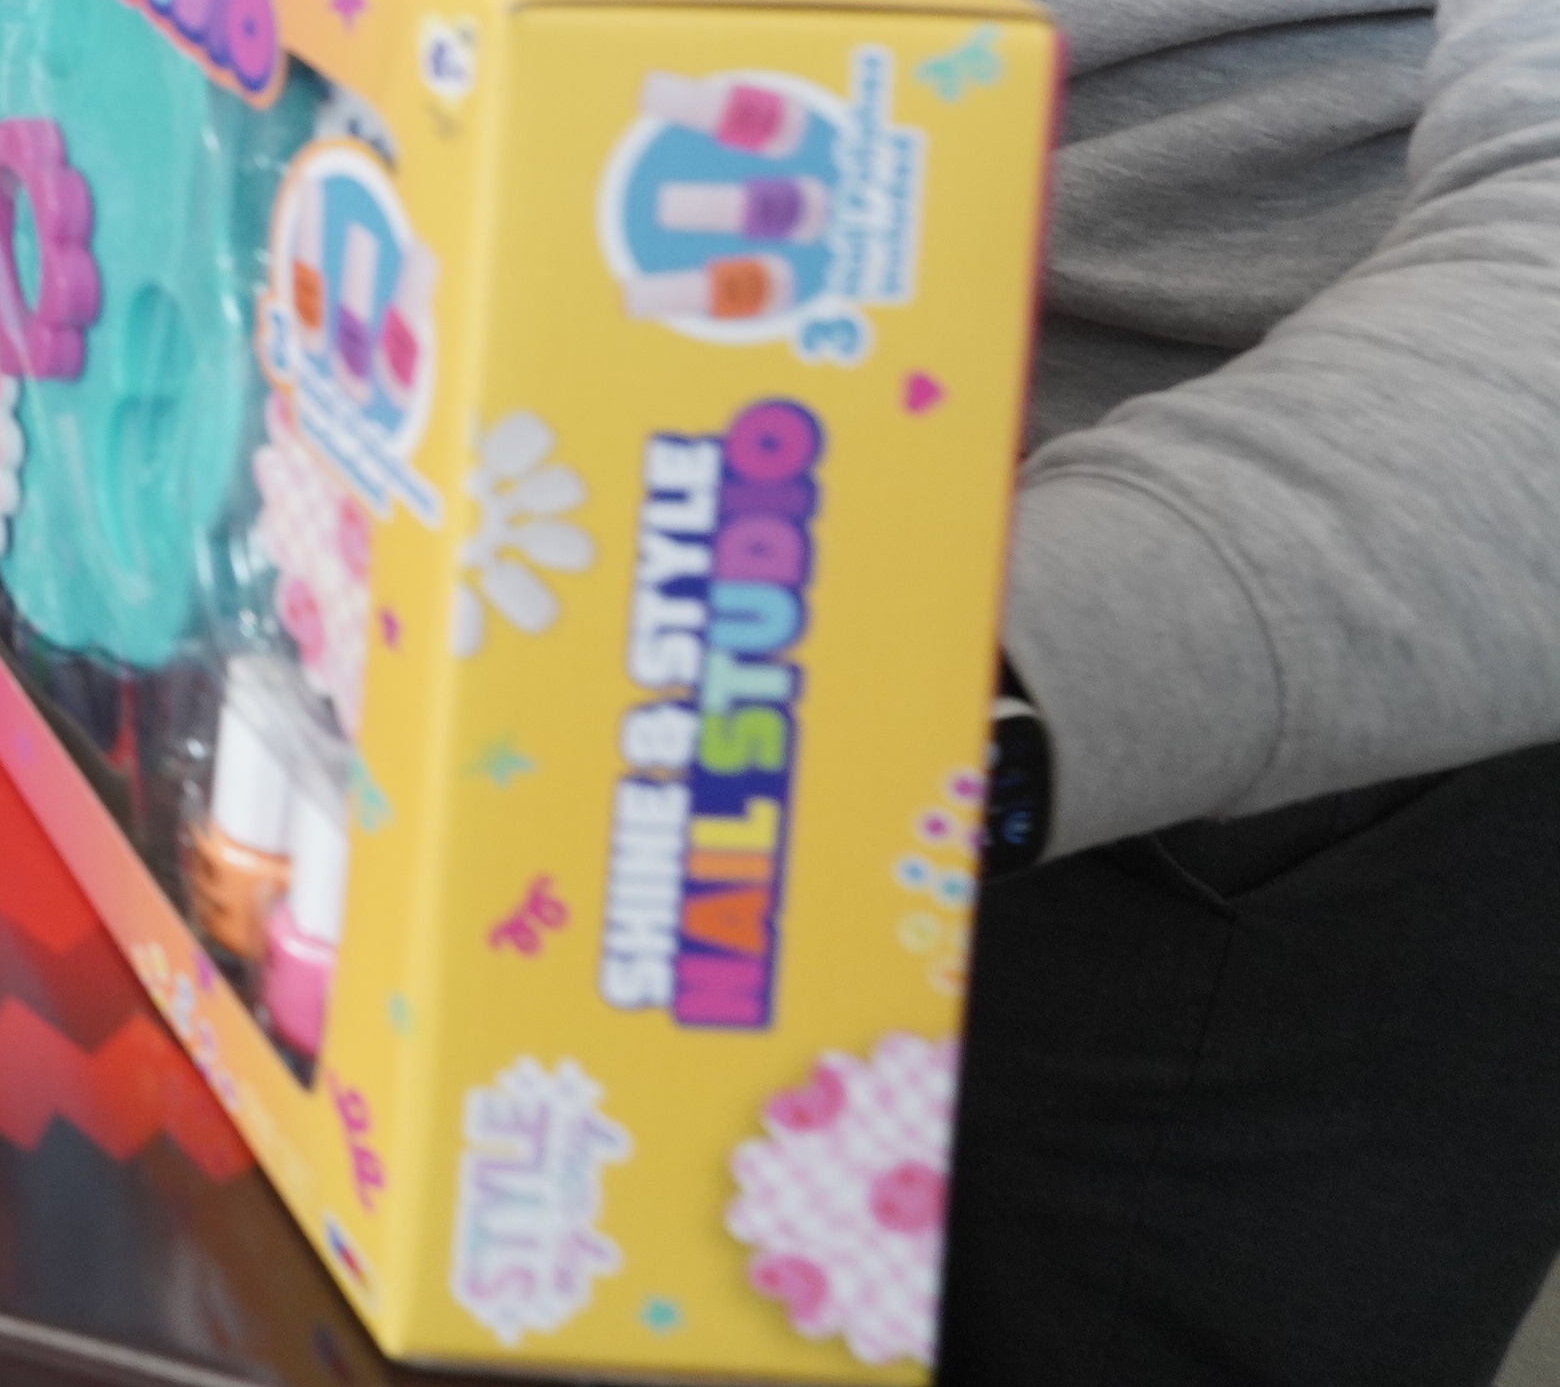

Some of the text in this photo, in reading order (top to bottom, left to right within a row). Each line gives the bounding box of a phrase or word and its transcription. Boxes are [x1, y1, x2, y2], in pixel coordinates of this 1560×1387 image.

[600, 433, 725, 1009] SHINE & STYLE
[671, 399, 823, 1032] NAIL STUDIO
